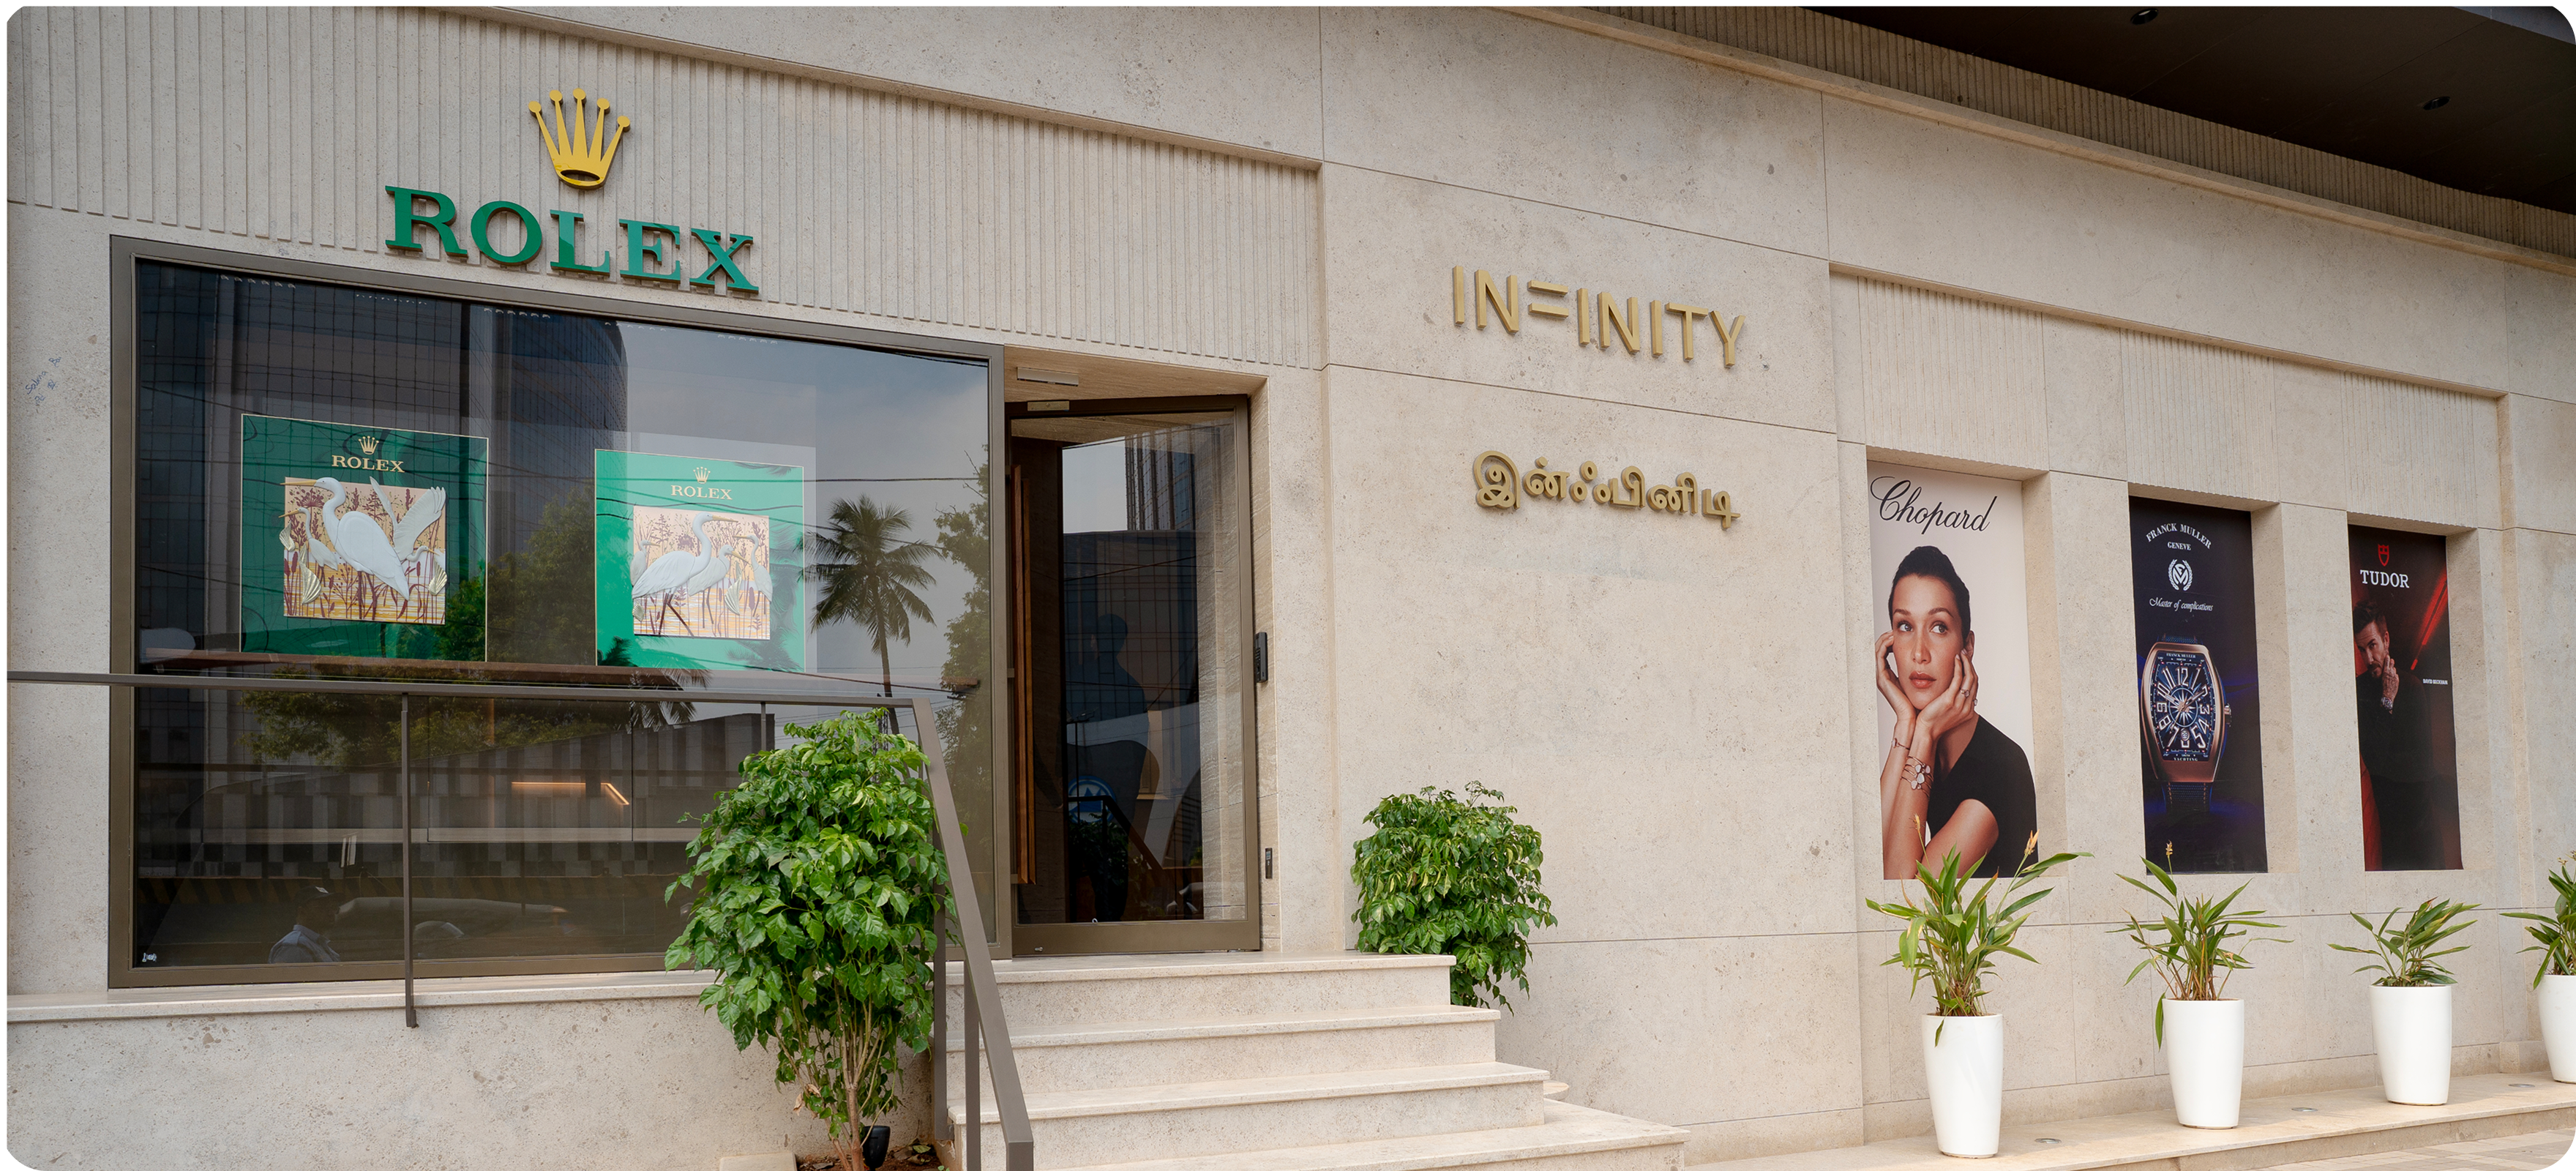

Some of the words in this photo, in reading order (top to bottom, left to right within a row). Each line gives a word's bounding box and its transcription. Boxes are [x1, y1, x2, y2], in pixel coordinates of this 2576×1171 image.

[385, 185, 759, 293] ROLEX
[332, 454, 405, 473] ROLEX
[671, 485, 733, 500] ROLEX
[1473, 450, 1741, 529] இன்ஃபினிடி
[1870, 476, 1998, 534] Chopard
[2146, 523, 2178, 542] FRANCK
[2179, 523, 2212, 549] MULLER
[2167, 541, 2192, 550] GENEVE
[2359, 569, 2410, 588] TUDOR
[2149, 596, 2173, 607] Master
[2174, 599, 2182, 612] of
[2181, 601, 2213, 613] complications
[2161, 665, 2176, 689] 11
[2175, 666, 2189, 686] 12
[2190, 667, 2202, 690] 1
[2200, 703, 2210, 714] 3
[2158, 714, 2172, 730] 8
[2198, 718, 2210, 734] 4
[2190, 725, 2206, 748] 5
